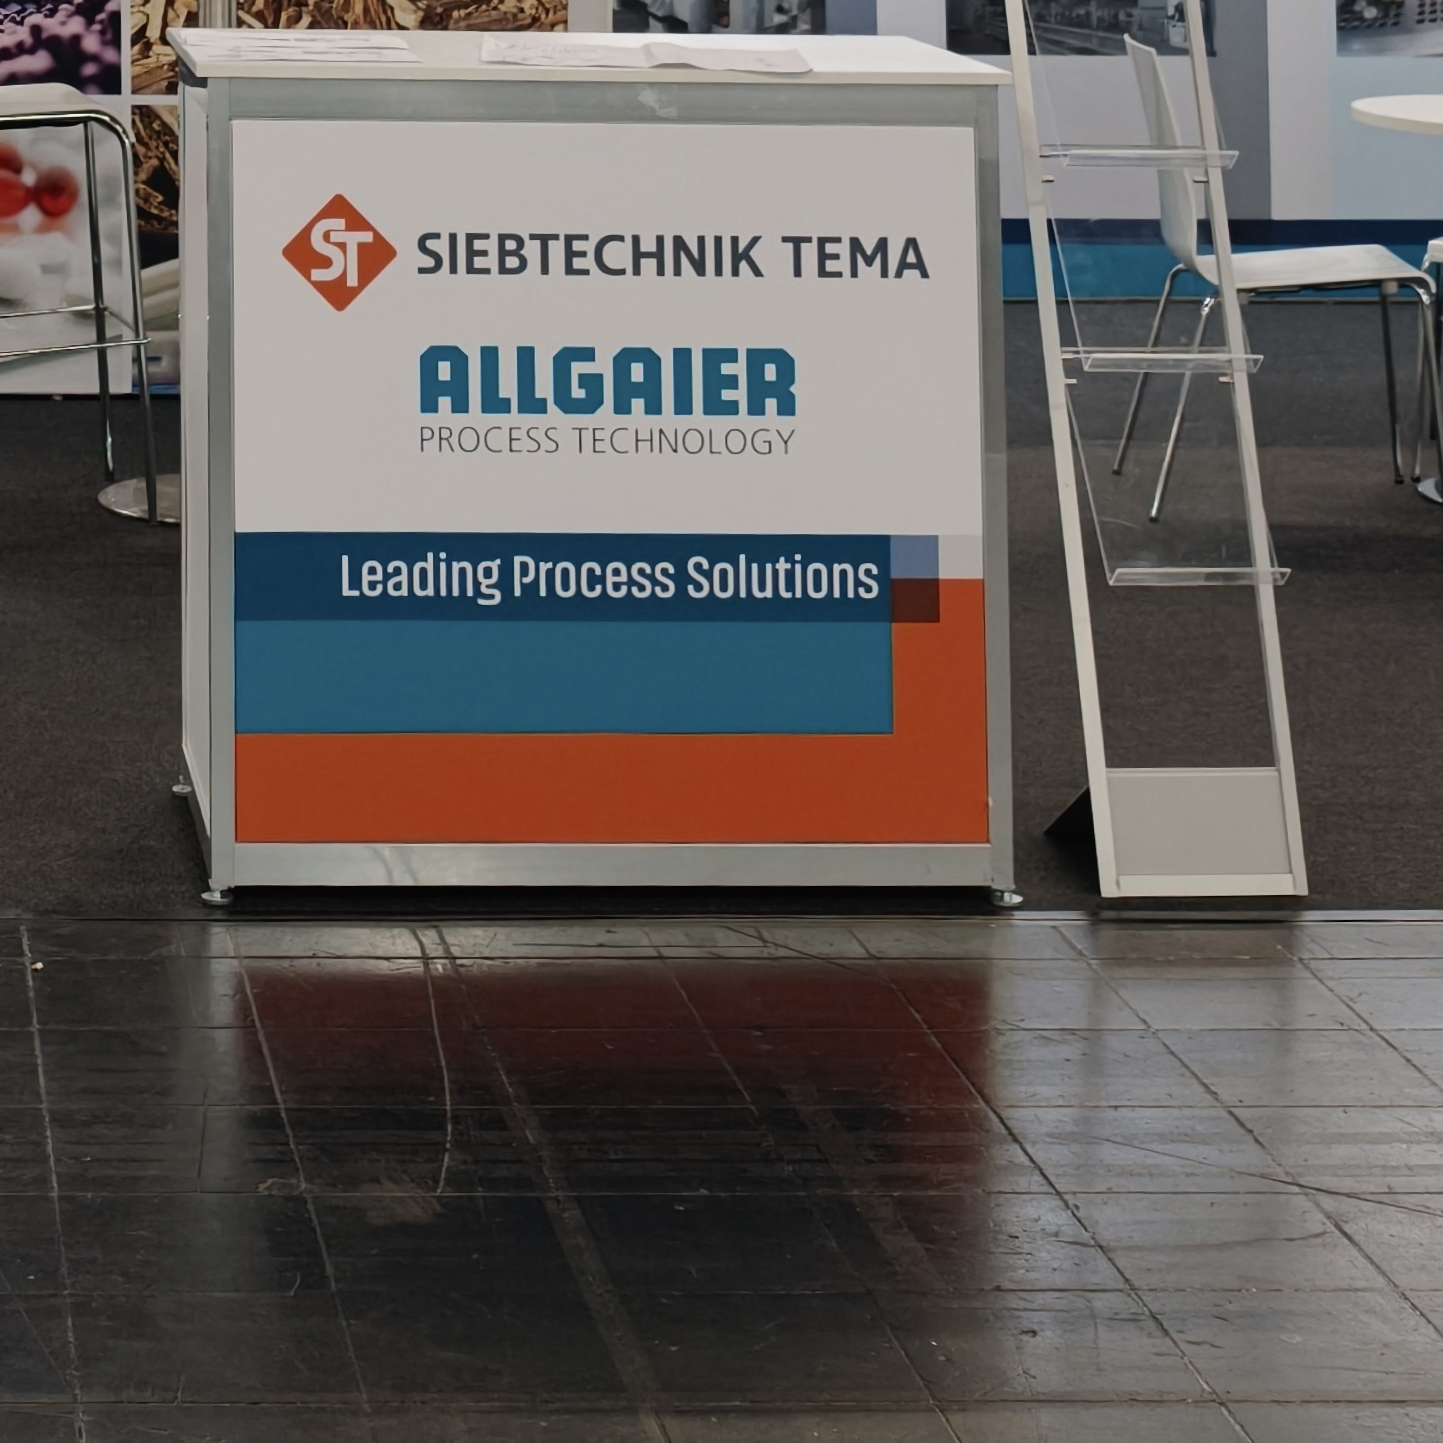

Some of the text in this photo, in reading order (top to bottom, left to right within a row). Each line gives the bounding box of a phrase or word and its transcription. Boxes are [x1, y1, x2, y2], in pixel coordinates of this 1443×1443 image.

[416, 231, 764, 278] SIEBTECHNIK
[781, 235, 930, 280] TEMA
[419, 345, 796, 417] ALLGAIER
[419, 426, 796, 455] PROCESS TECHNOLOGY
[340, 553, 880, 605] Leading Process Solutions
